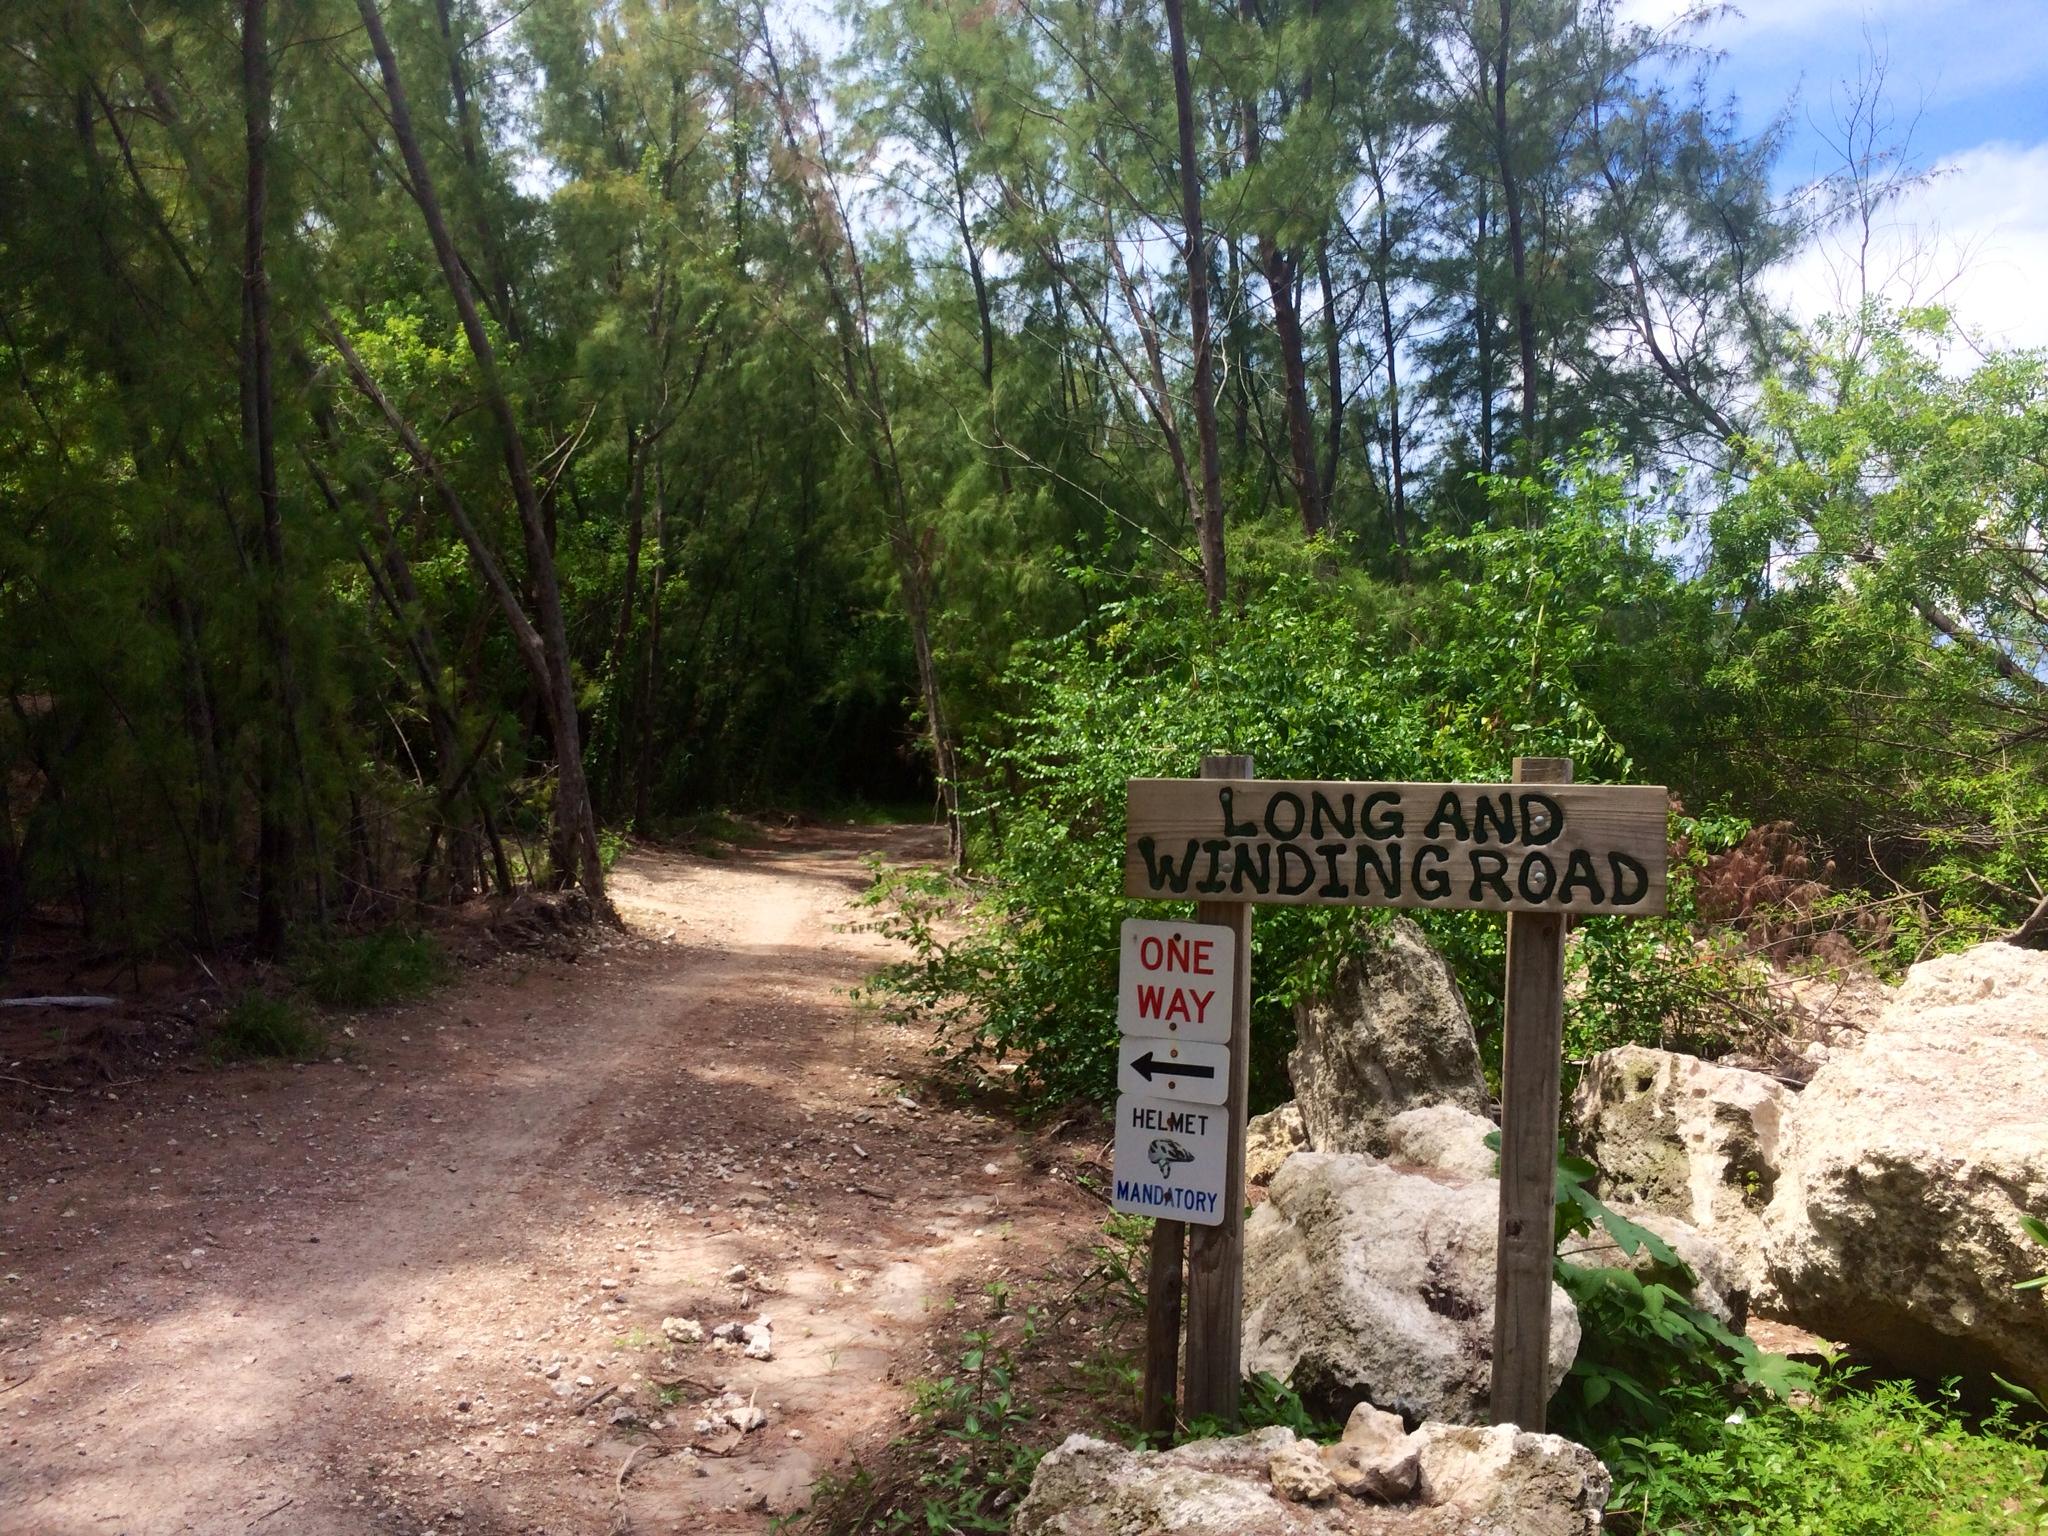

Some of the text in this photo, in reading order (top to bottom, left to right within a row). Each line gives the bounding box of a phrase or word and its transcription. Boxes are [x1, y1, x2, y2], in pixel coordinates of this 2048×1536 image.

[1219, 786, 1564, 847] LONG AND
[1136, 835, 1649, 906] WINDING ROAD
[1140, 936, 1215, 975] ONE
[1136, 984, 1215, 1024] WAY
[1132, 1107, 1208, 1136] HELMET
[1117, 1180, 1217, 1213] MANDATORY
